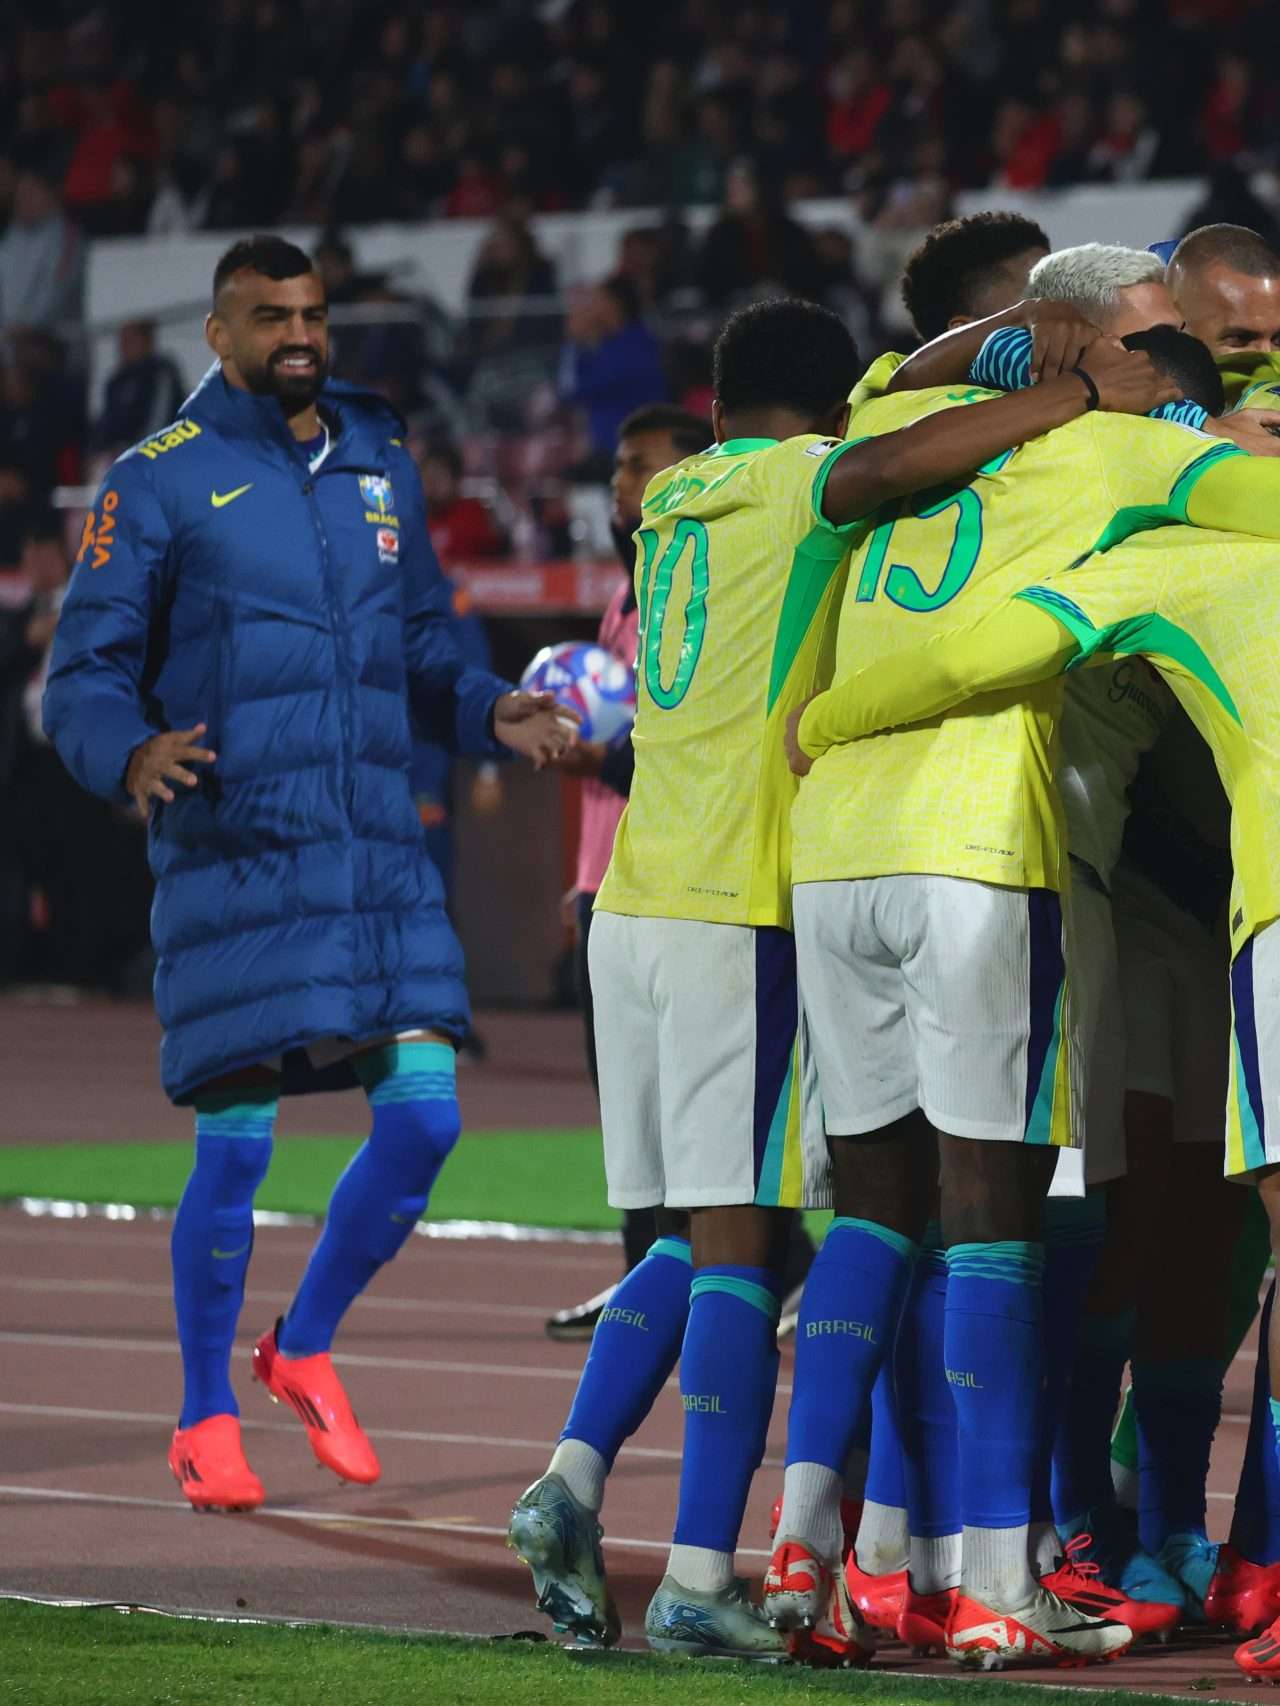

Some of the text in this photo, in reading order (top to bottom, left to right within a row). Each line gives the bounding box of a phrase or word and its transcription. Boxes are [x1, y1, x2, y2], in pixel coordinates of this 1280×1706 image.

[91, 490, 119, 570] vivo
[600, 1307, 649, 1331] RASIL
[806, 1320, 877, 1345] BRASIL
[945, 1368, 984, 1389] ASIL
